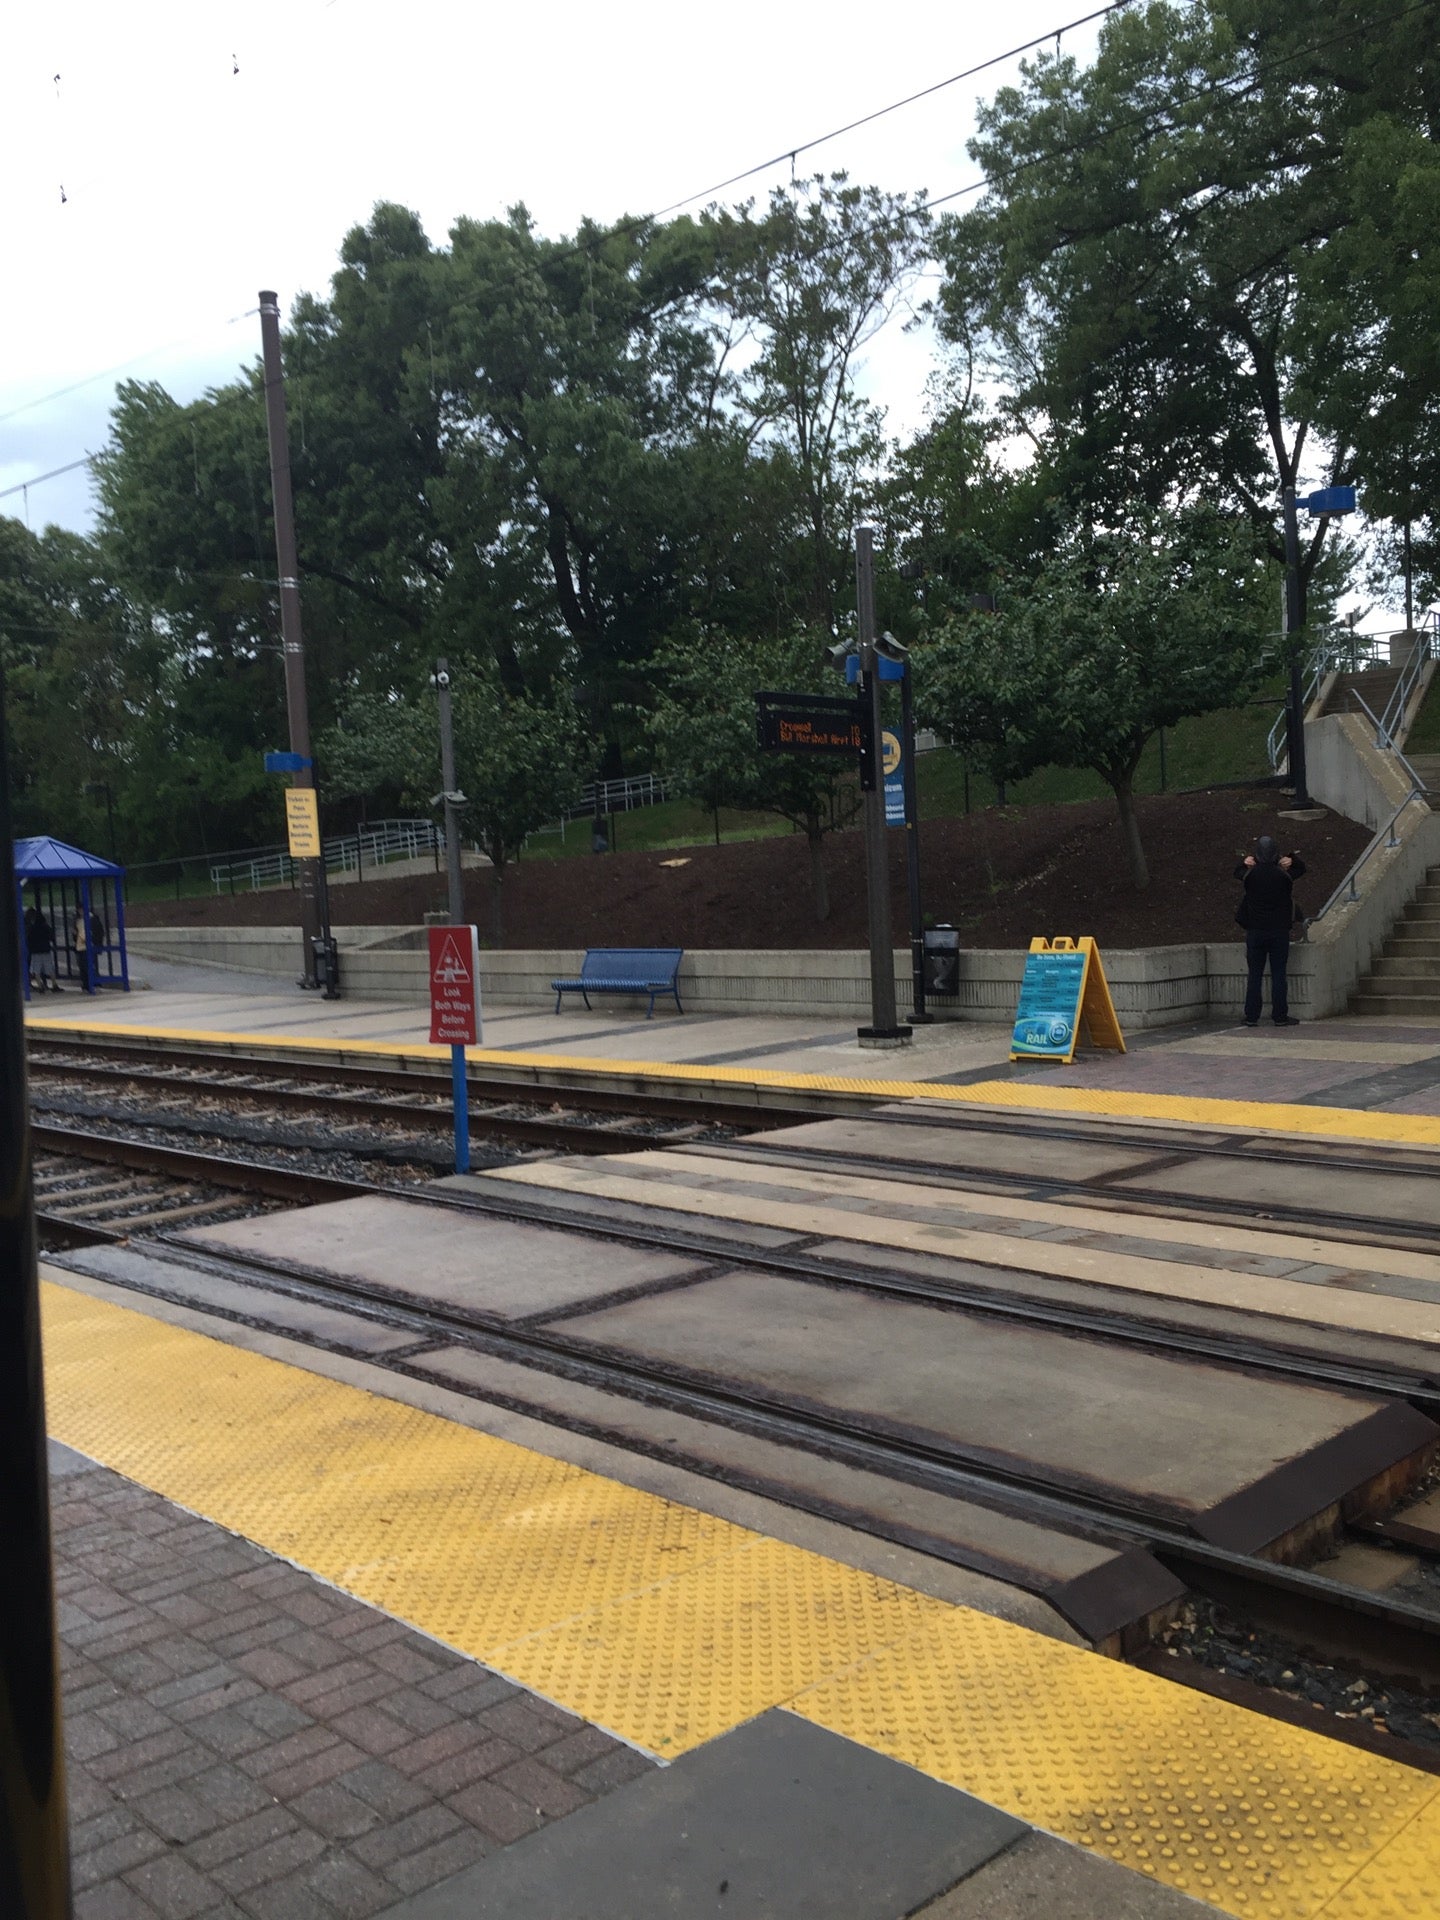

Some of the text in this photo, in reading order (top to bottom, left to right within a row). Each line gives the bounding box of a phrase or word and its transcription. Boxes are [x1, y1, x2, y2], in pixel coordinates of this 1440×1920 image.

[443, 987, 461, 998] Look
[434, 1000, 471, 1013] Both Ways
[441, 1014, 465, 1025] Before
[437, 1027, 470, 1041] Crossing
[1026, 1033, 1048, 1045] RAIL
